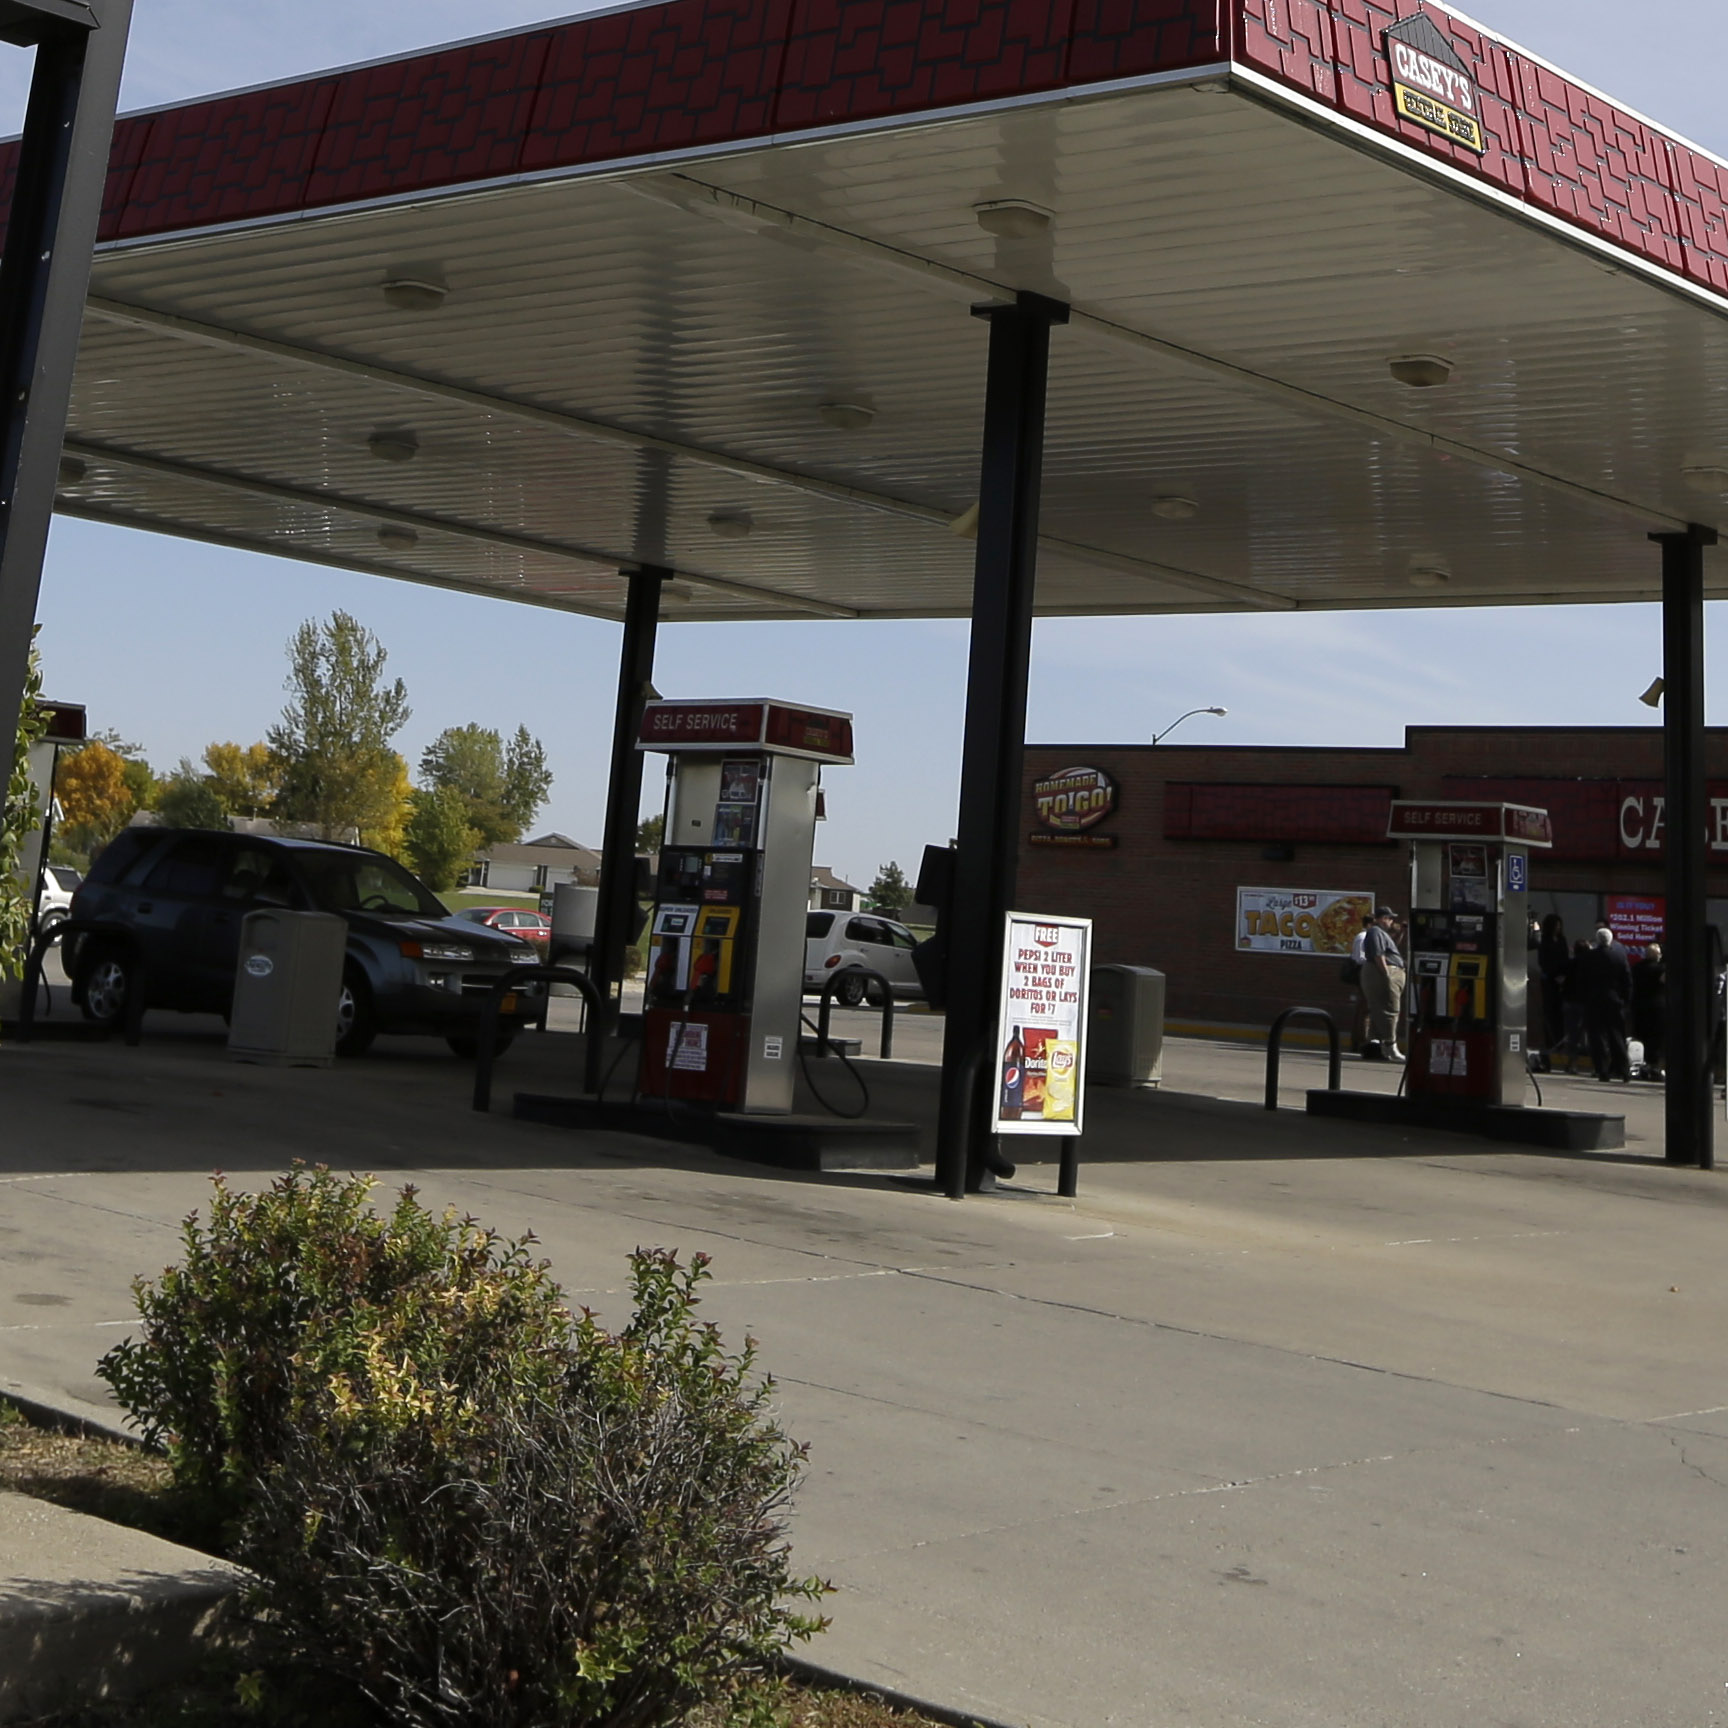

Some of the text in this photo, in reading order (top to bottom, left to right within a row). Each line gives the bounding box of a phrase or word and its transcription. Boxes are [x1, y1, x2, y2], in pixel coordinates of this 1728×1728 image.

[1394, 43, 1473, 111] CASEY'S
[653, 713, 739, 731] SELF SERVICE
[1035, 774, 1097, 793] HOMEMADE
[1403, 811, 1482, 826] SELF SERVICE
[1245, 909, 1316, 939] TACO
[1035, 927, 1058, 942] FREE
[1280, 939, 1303, 950] PIZZA
[1018, 948, 1073, 964] PEPSI 2 LITER
[1014, 961, 1076, 977] WHEN YOU BUY
[1024, 976, 1065, 989] 2 BAGS OF
[1009, 988, 1077, 1003] DORITOS OR LAYS
[1030, 1002, 1046, 1014] FOR
